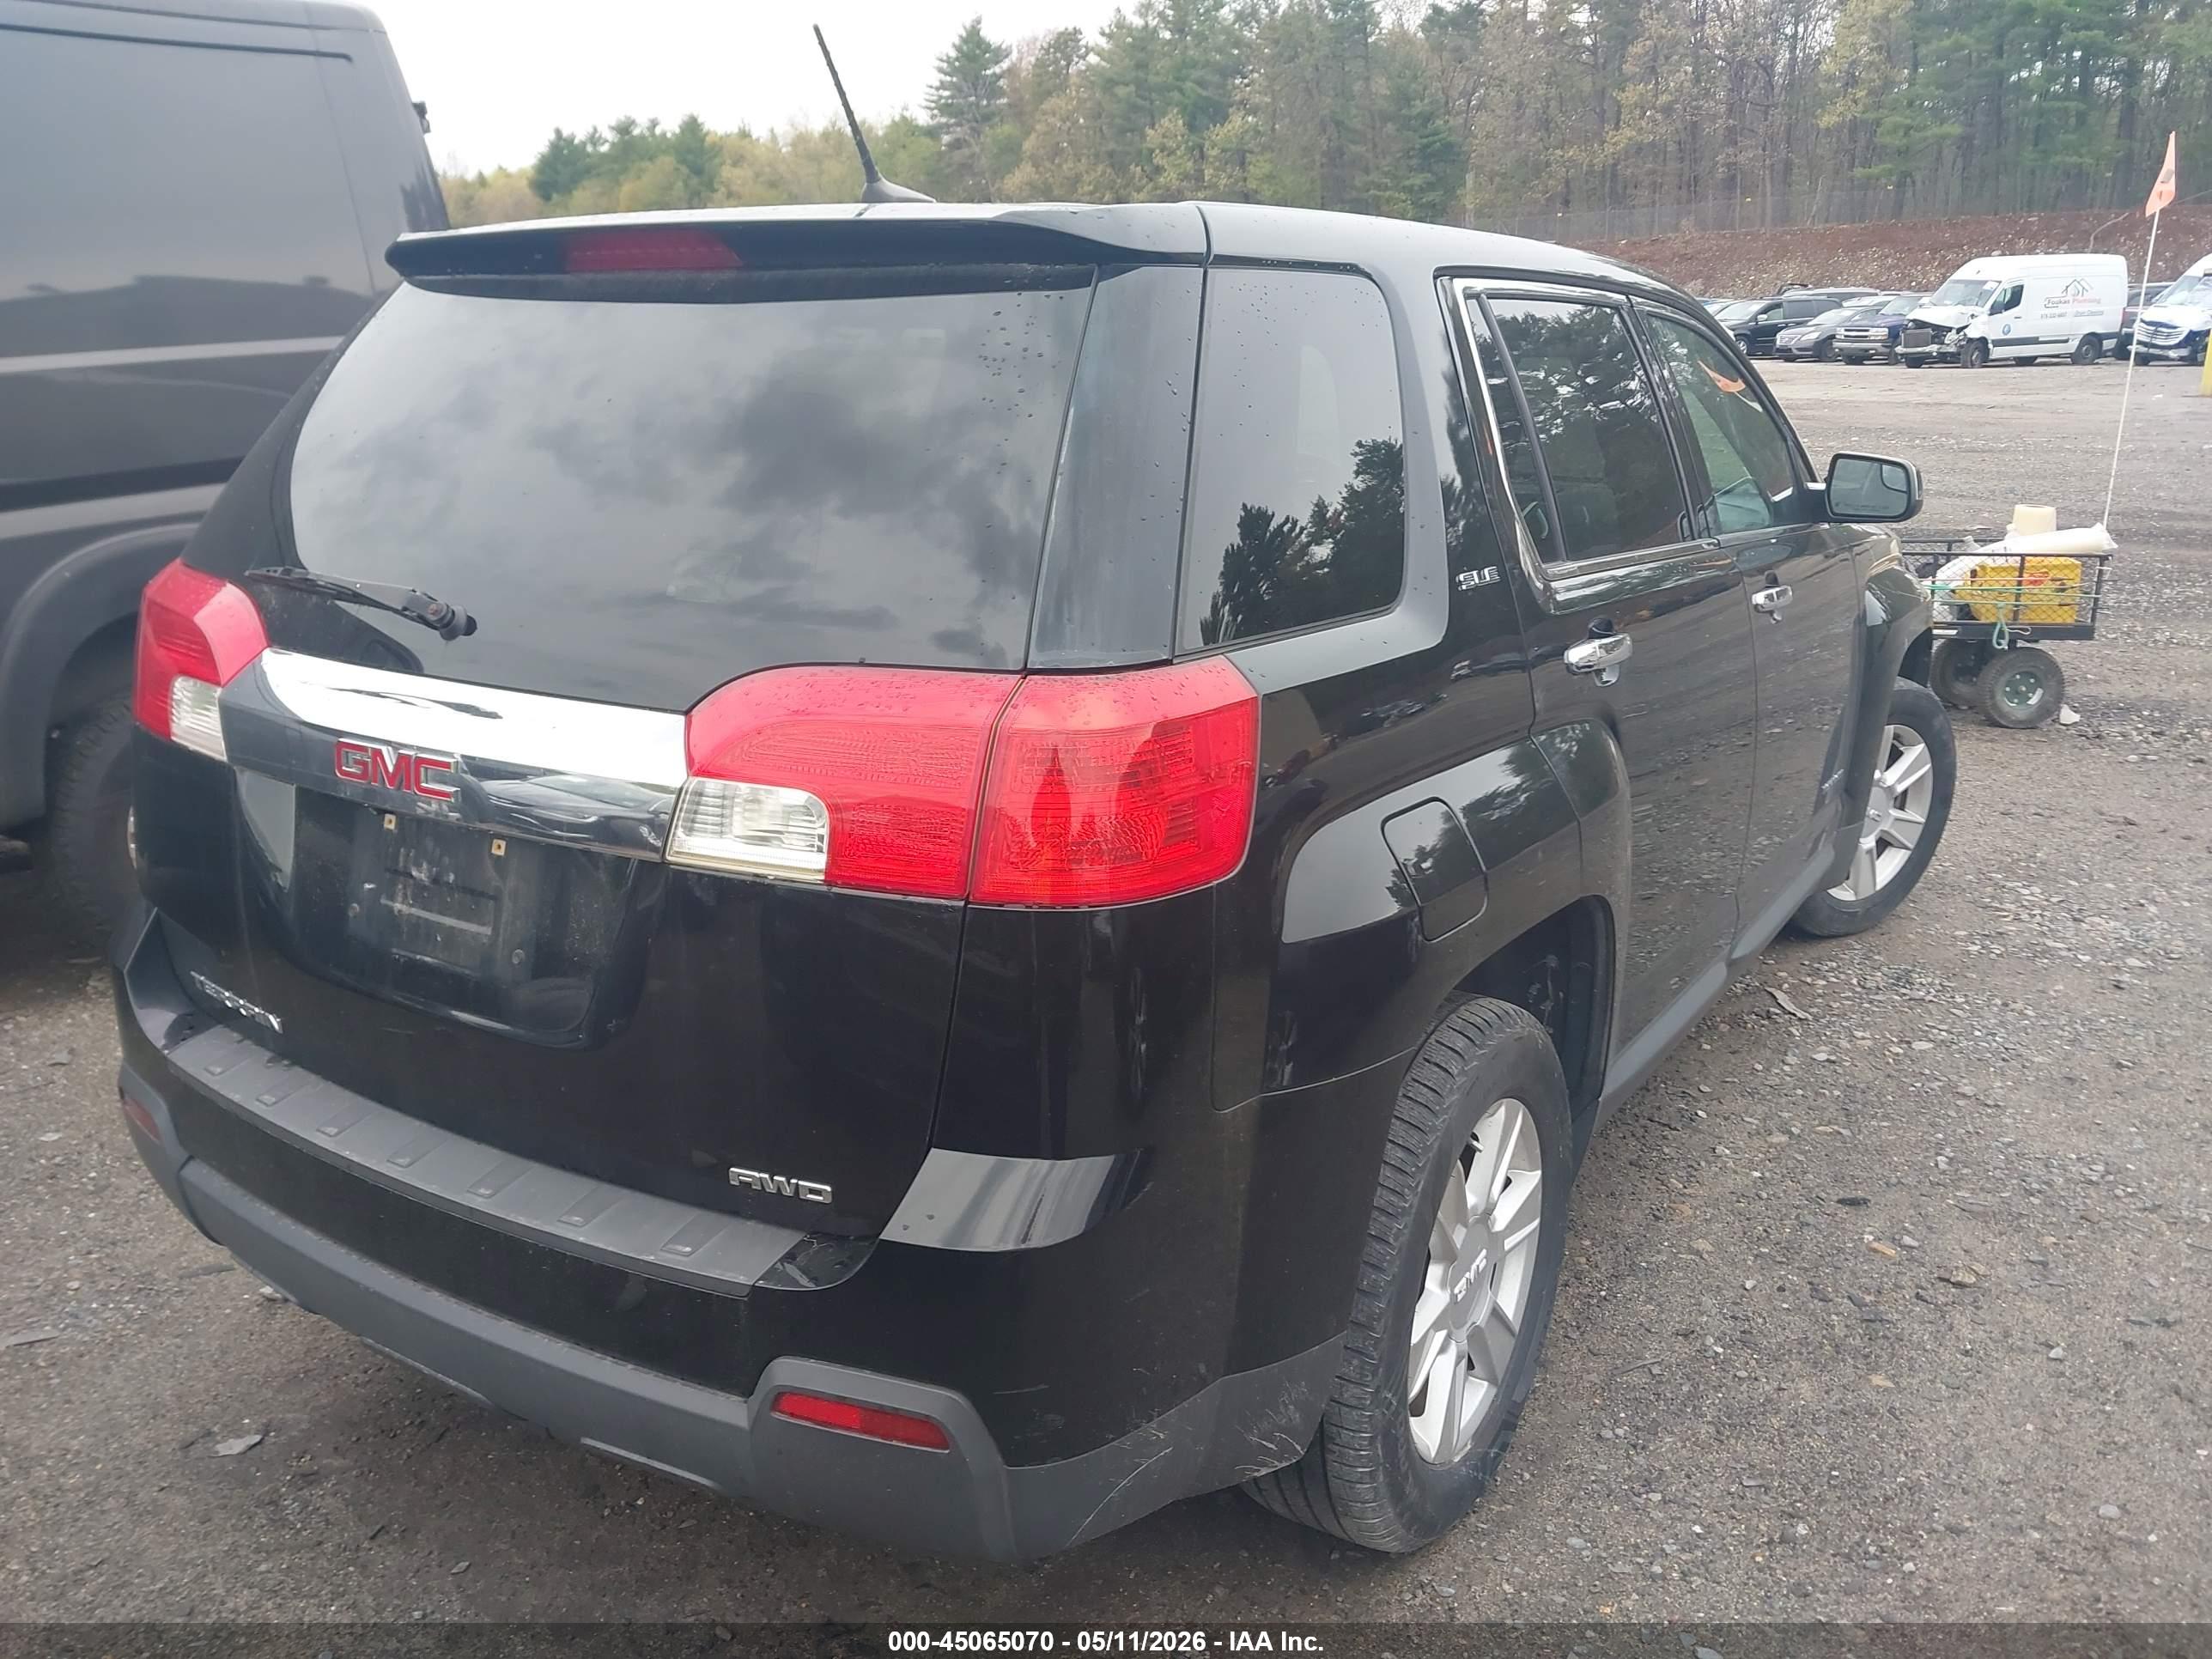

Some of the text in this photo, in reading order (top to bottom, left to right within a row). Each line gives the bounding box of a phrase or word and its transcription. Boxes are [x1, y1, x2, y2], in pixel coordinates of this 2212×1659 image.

[1455, 566, 1500, 591] SLE
[335, 738, 461, 802] GMC
[729, 1167, 832, 1204] AWD
